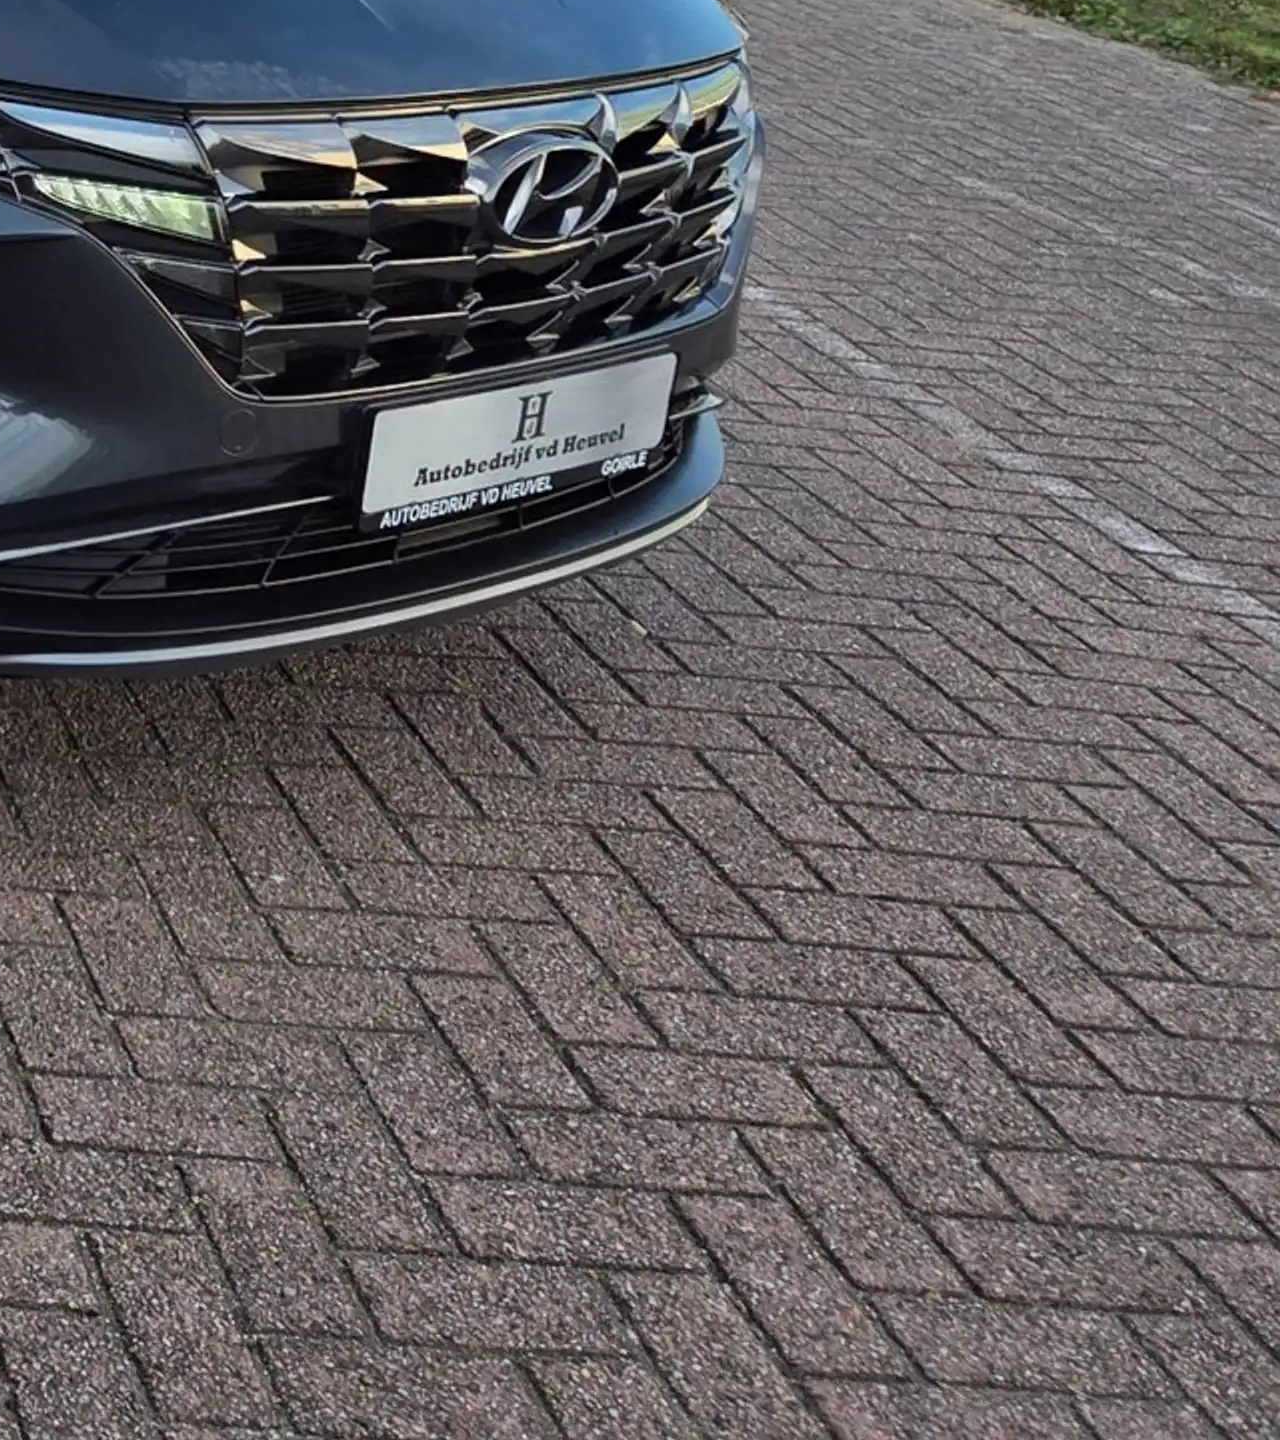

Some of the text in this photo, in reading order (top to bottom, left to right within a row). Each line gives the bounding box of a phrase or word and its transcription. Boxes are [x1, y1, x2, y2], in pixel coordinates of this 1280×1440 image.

[512, 391, 554, 444] H
[413, 423, 626, 487] Autobedrijf vd Heuvel
[380, 450, 648, 529] AUTOBEDRIJF VD HEUVEL GOIRLE
